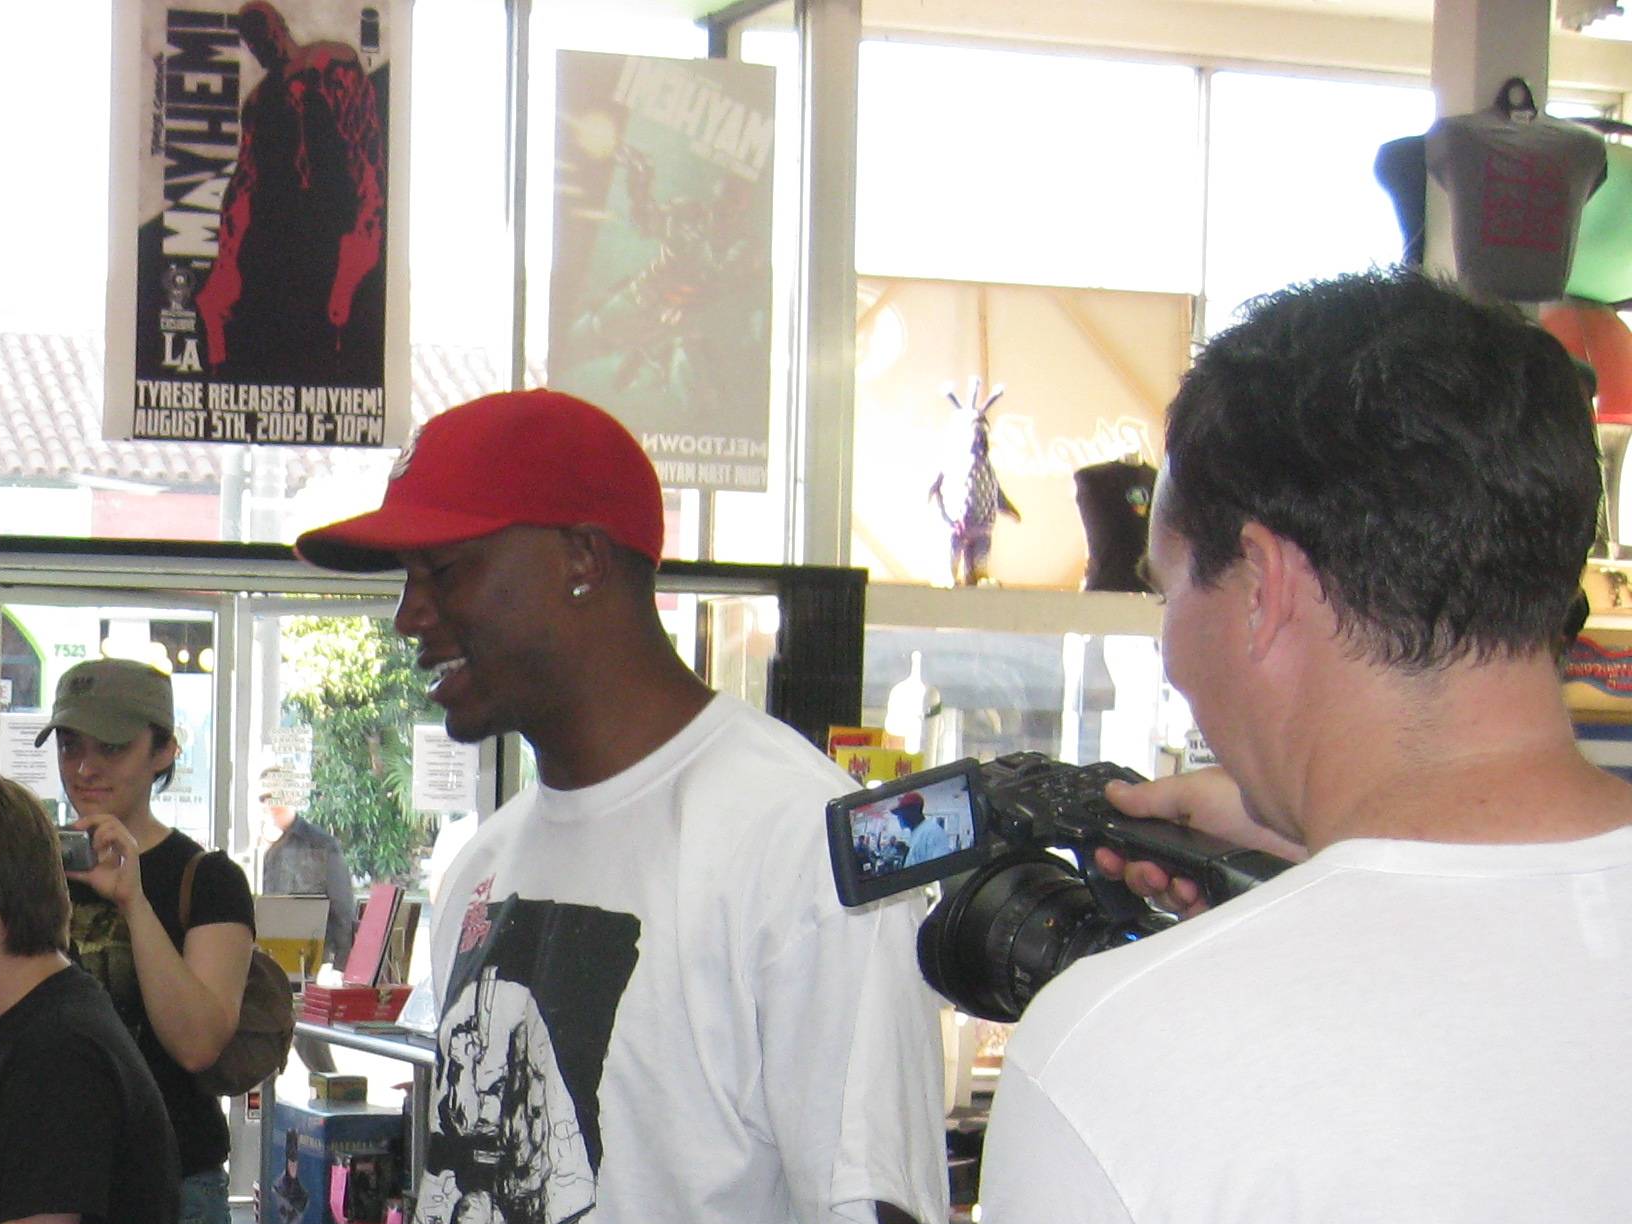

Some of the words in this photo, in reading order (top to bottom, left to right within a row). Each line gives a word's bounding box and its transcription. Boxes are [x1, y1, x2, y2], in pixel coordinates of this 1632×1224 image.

[163, 9, 243, 256] MAYHEM!
[161, 332, 203, 373] LA
[136, 379, 204, 409] TYRESE
[207, 382, 296, 412] RELEASES
[300, 385, 384, 416] MAYHEM!
[134, 407, 207, 438] AUGUST
[211, 411, 252, 443] 5TH,
[256, 411, 308, 441] 2009
[311, 413, 384, 446] 6-10PM
[54, 643, 87, 658] 7523
